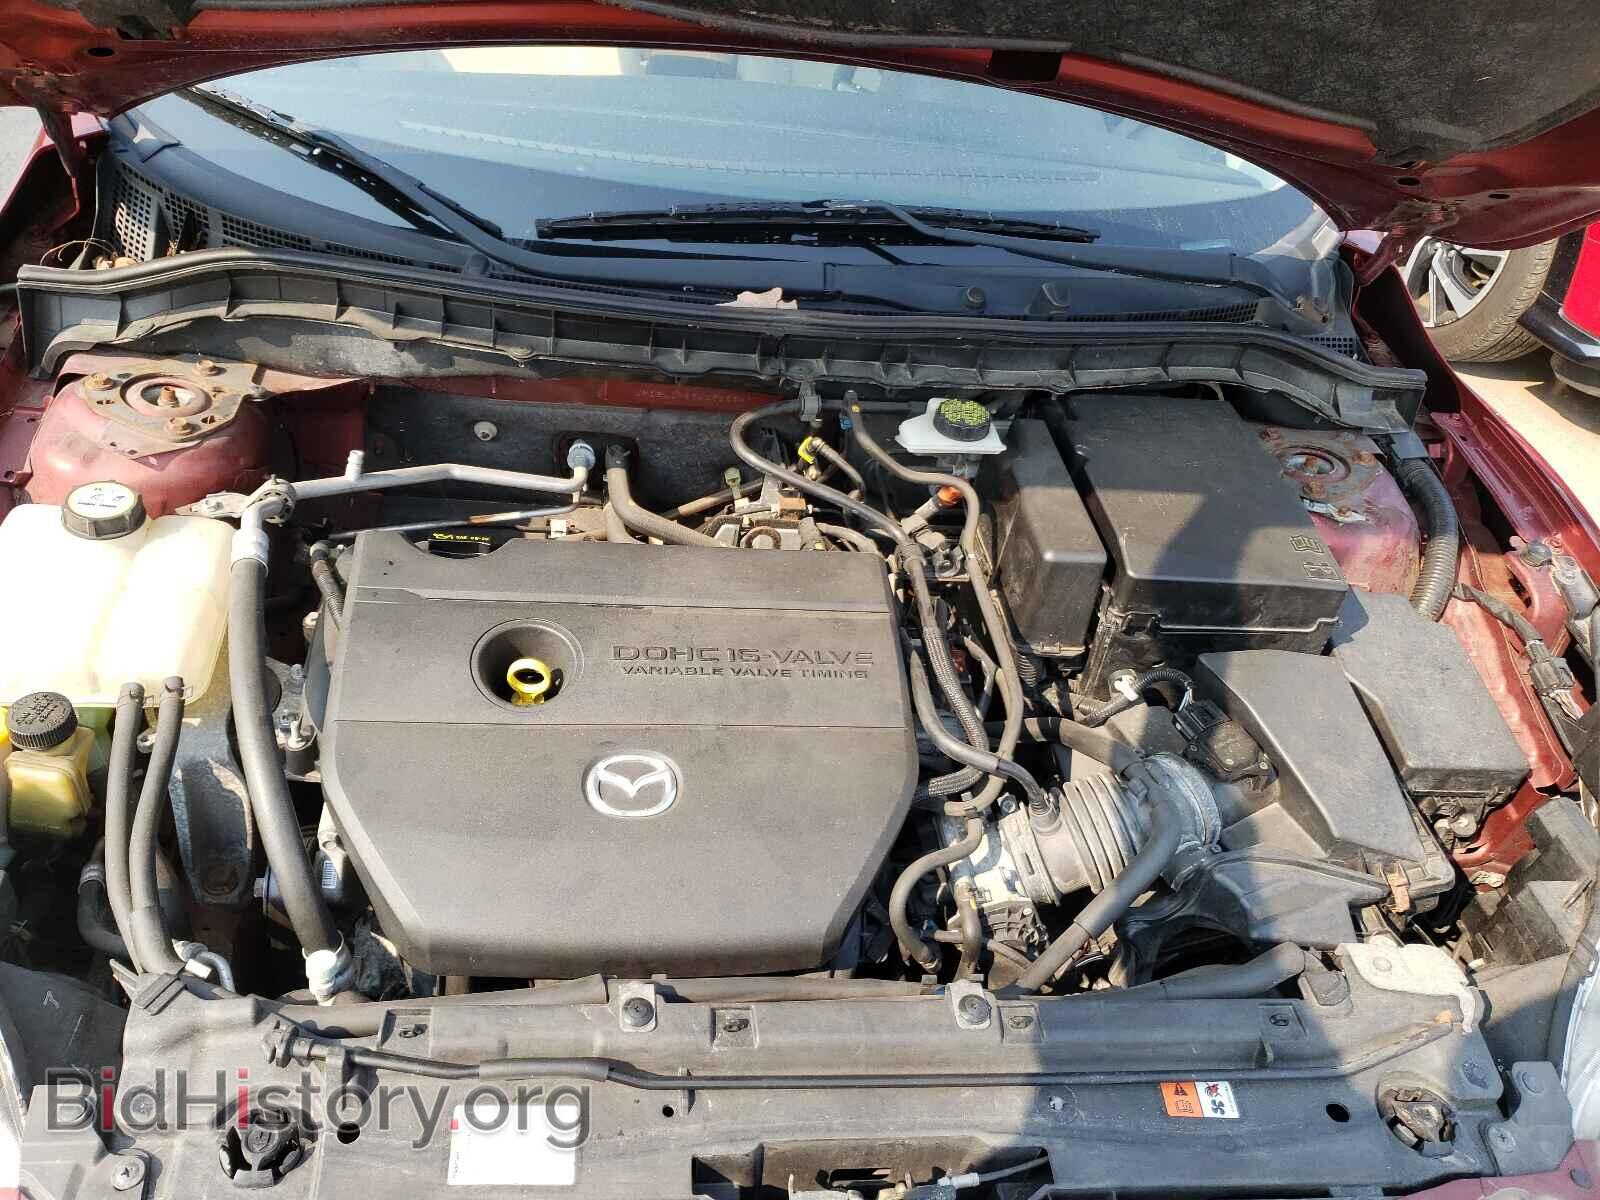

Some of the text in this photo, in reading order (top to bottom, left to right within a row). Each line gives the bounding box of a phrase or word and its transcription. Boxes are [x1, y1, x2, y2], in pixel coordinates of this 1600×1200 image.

[612, 645, 874, 665] DOHC 16-VALVE
[623, 665, 870, 680] VARIABLE VALVE TIMING
